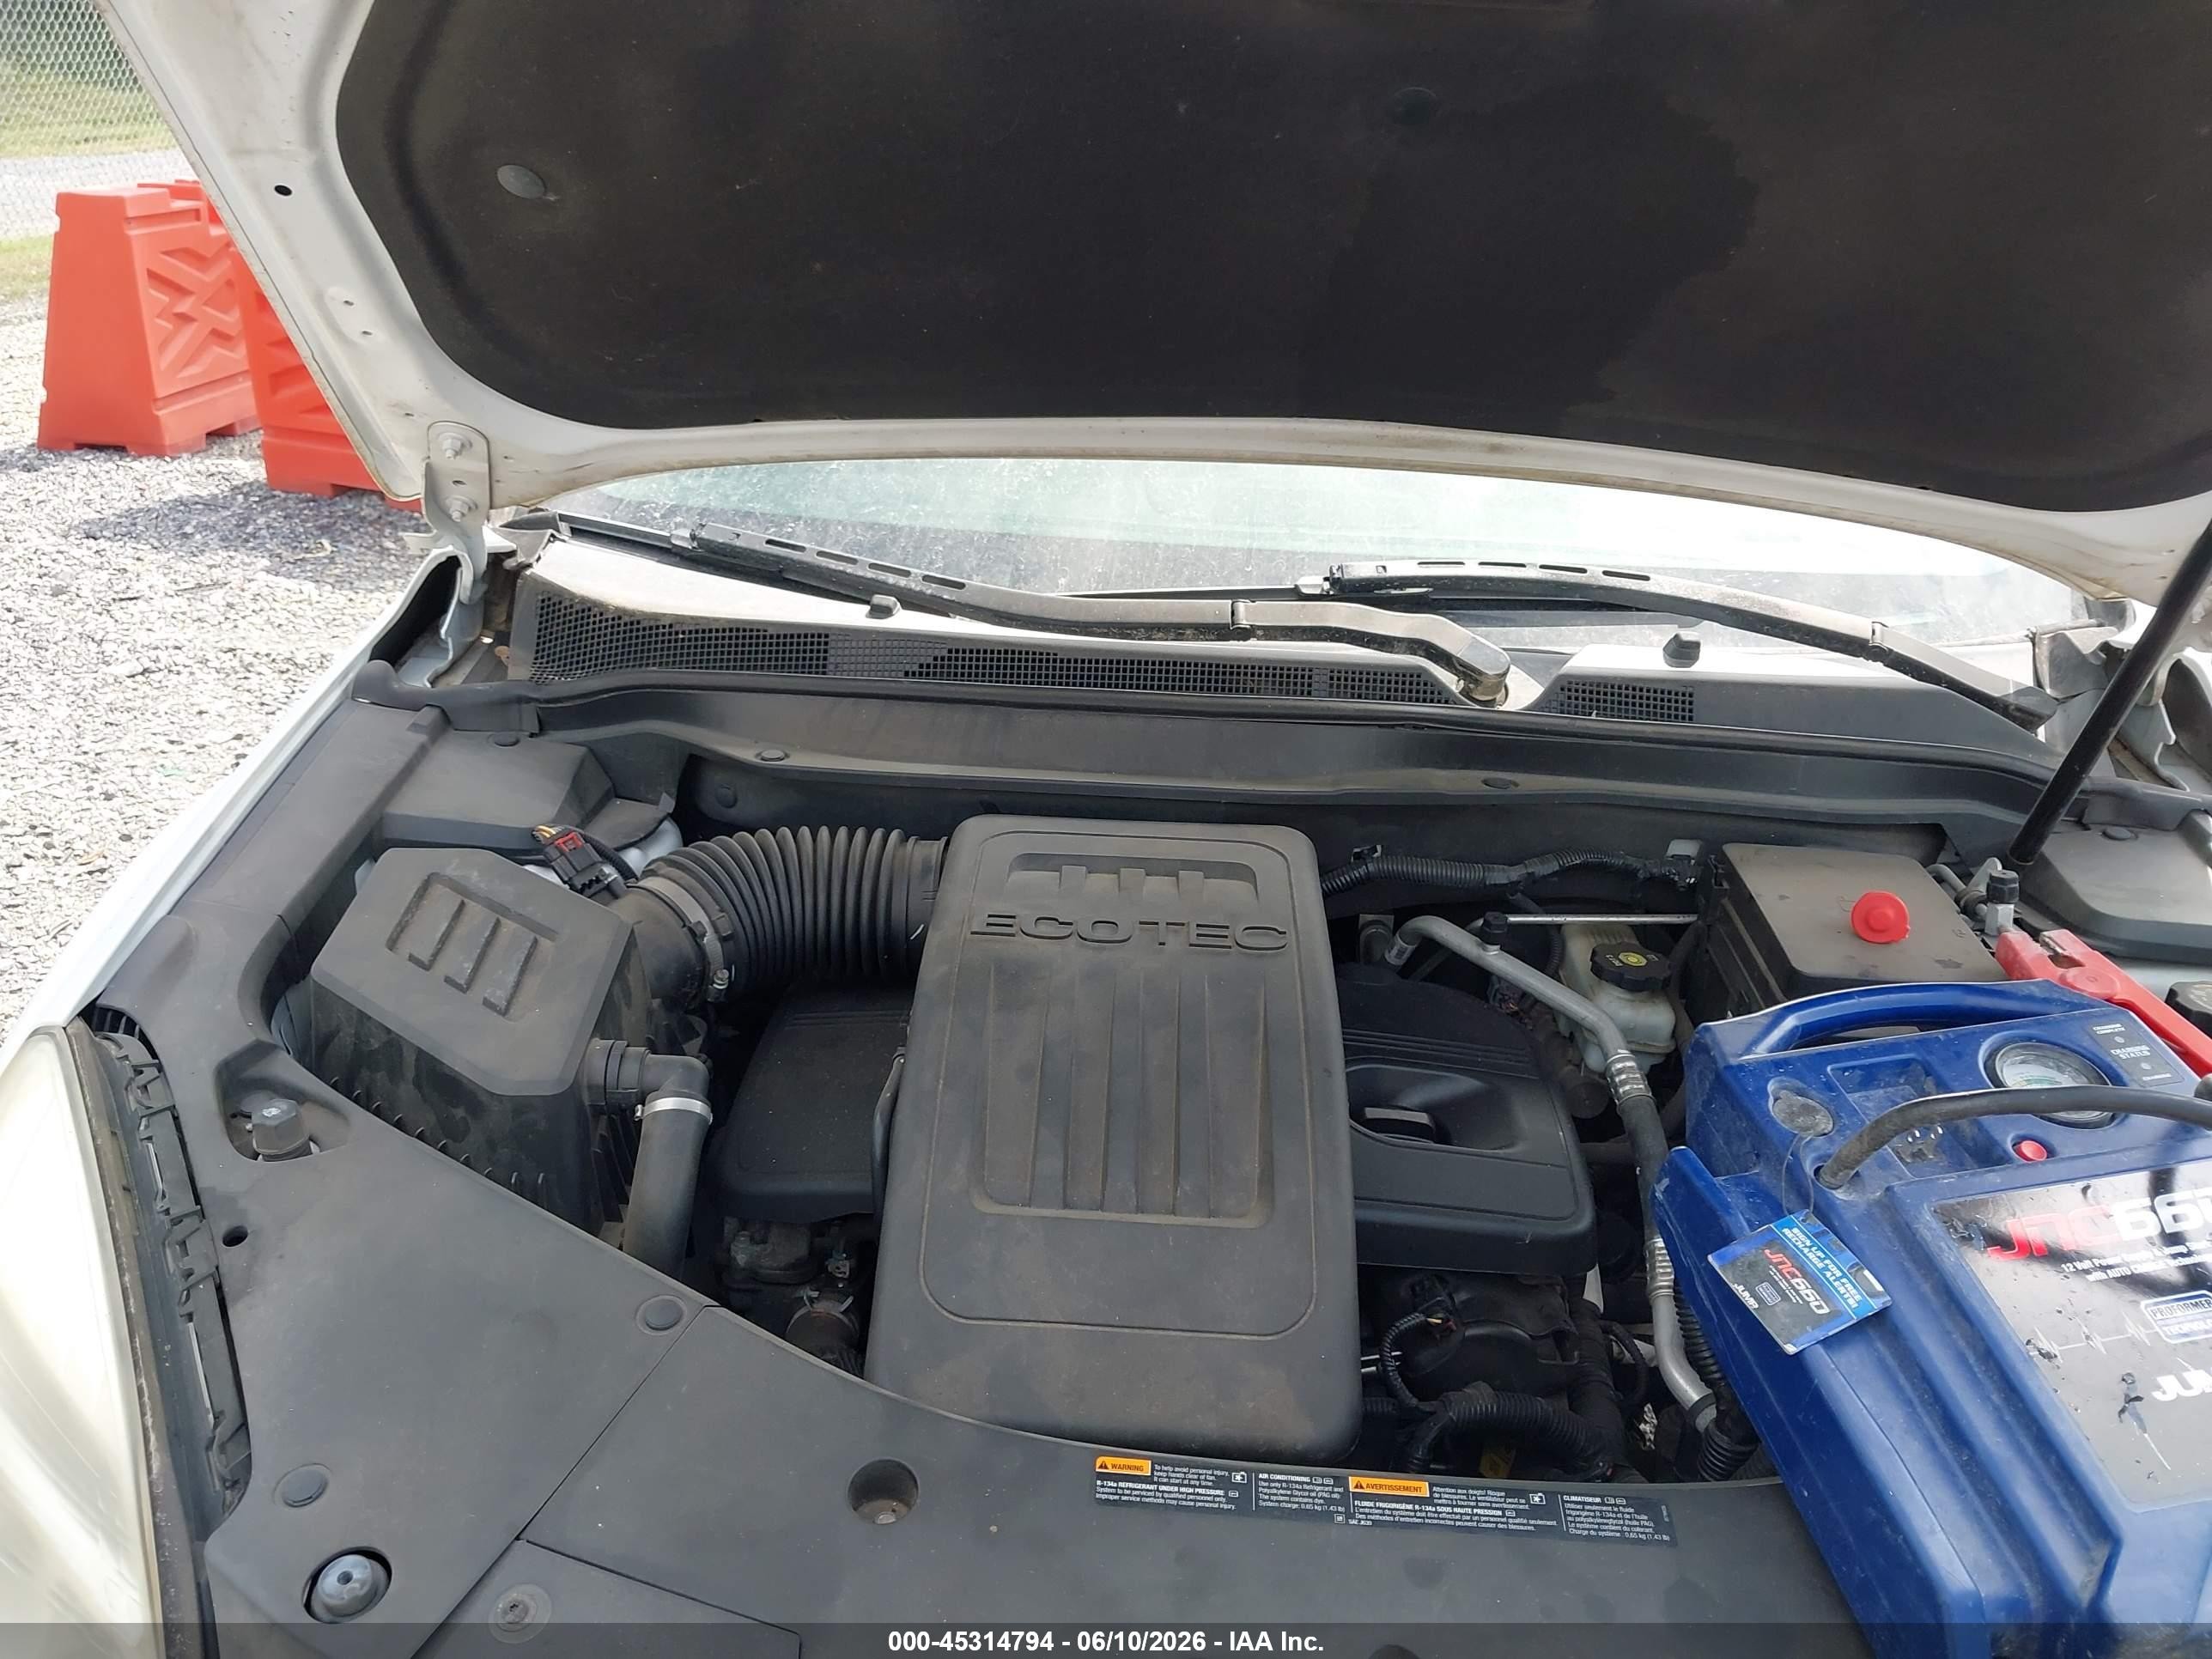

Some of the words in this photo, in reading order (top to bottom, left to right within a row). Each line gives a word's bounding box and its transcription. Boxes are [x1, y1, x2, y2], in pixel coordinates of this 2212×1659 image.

[970, 914, 1287, 951] ECOTEC
[2118, 1050, 2151, 1060] STATUS
[1782, 1228, 1825, 1269] RECHARGE
[1824, 1270, 1859, 1308] ALERTS!
[1791, 1227, 1812, 1247] SIGN
[1811, 1246, 1825, 1259] UP
[1823, 1259, 1842, 1277] FOR
[1839, 1278, 1862, 1301] FREE
[2062, 1261, 2075, 1273] 12
[2074, 1258, 2094, 1271] Volt
[2107, 1266, 2132, 1279] AUTO
[1110, 1463, 1145, 1472] WARNING
[1270, 1474, 1311, 1482] CONDITIONING
[1118, 1481, 1158, 1490] REFRIGERANT
[1366, 1483, 1422, 1492] AVERTISSEMENT
